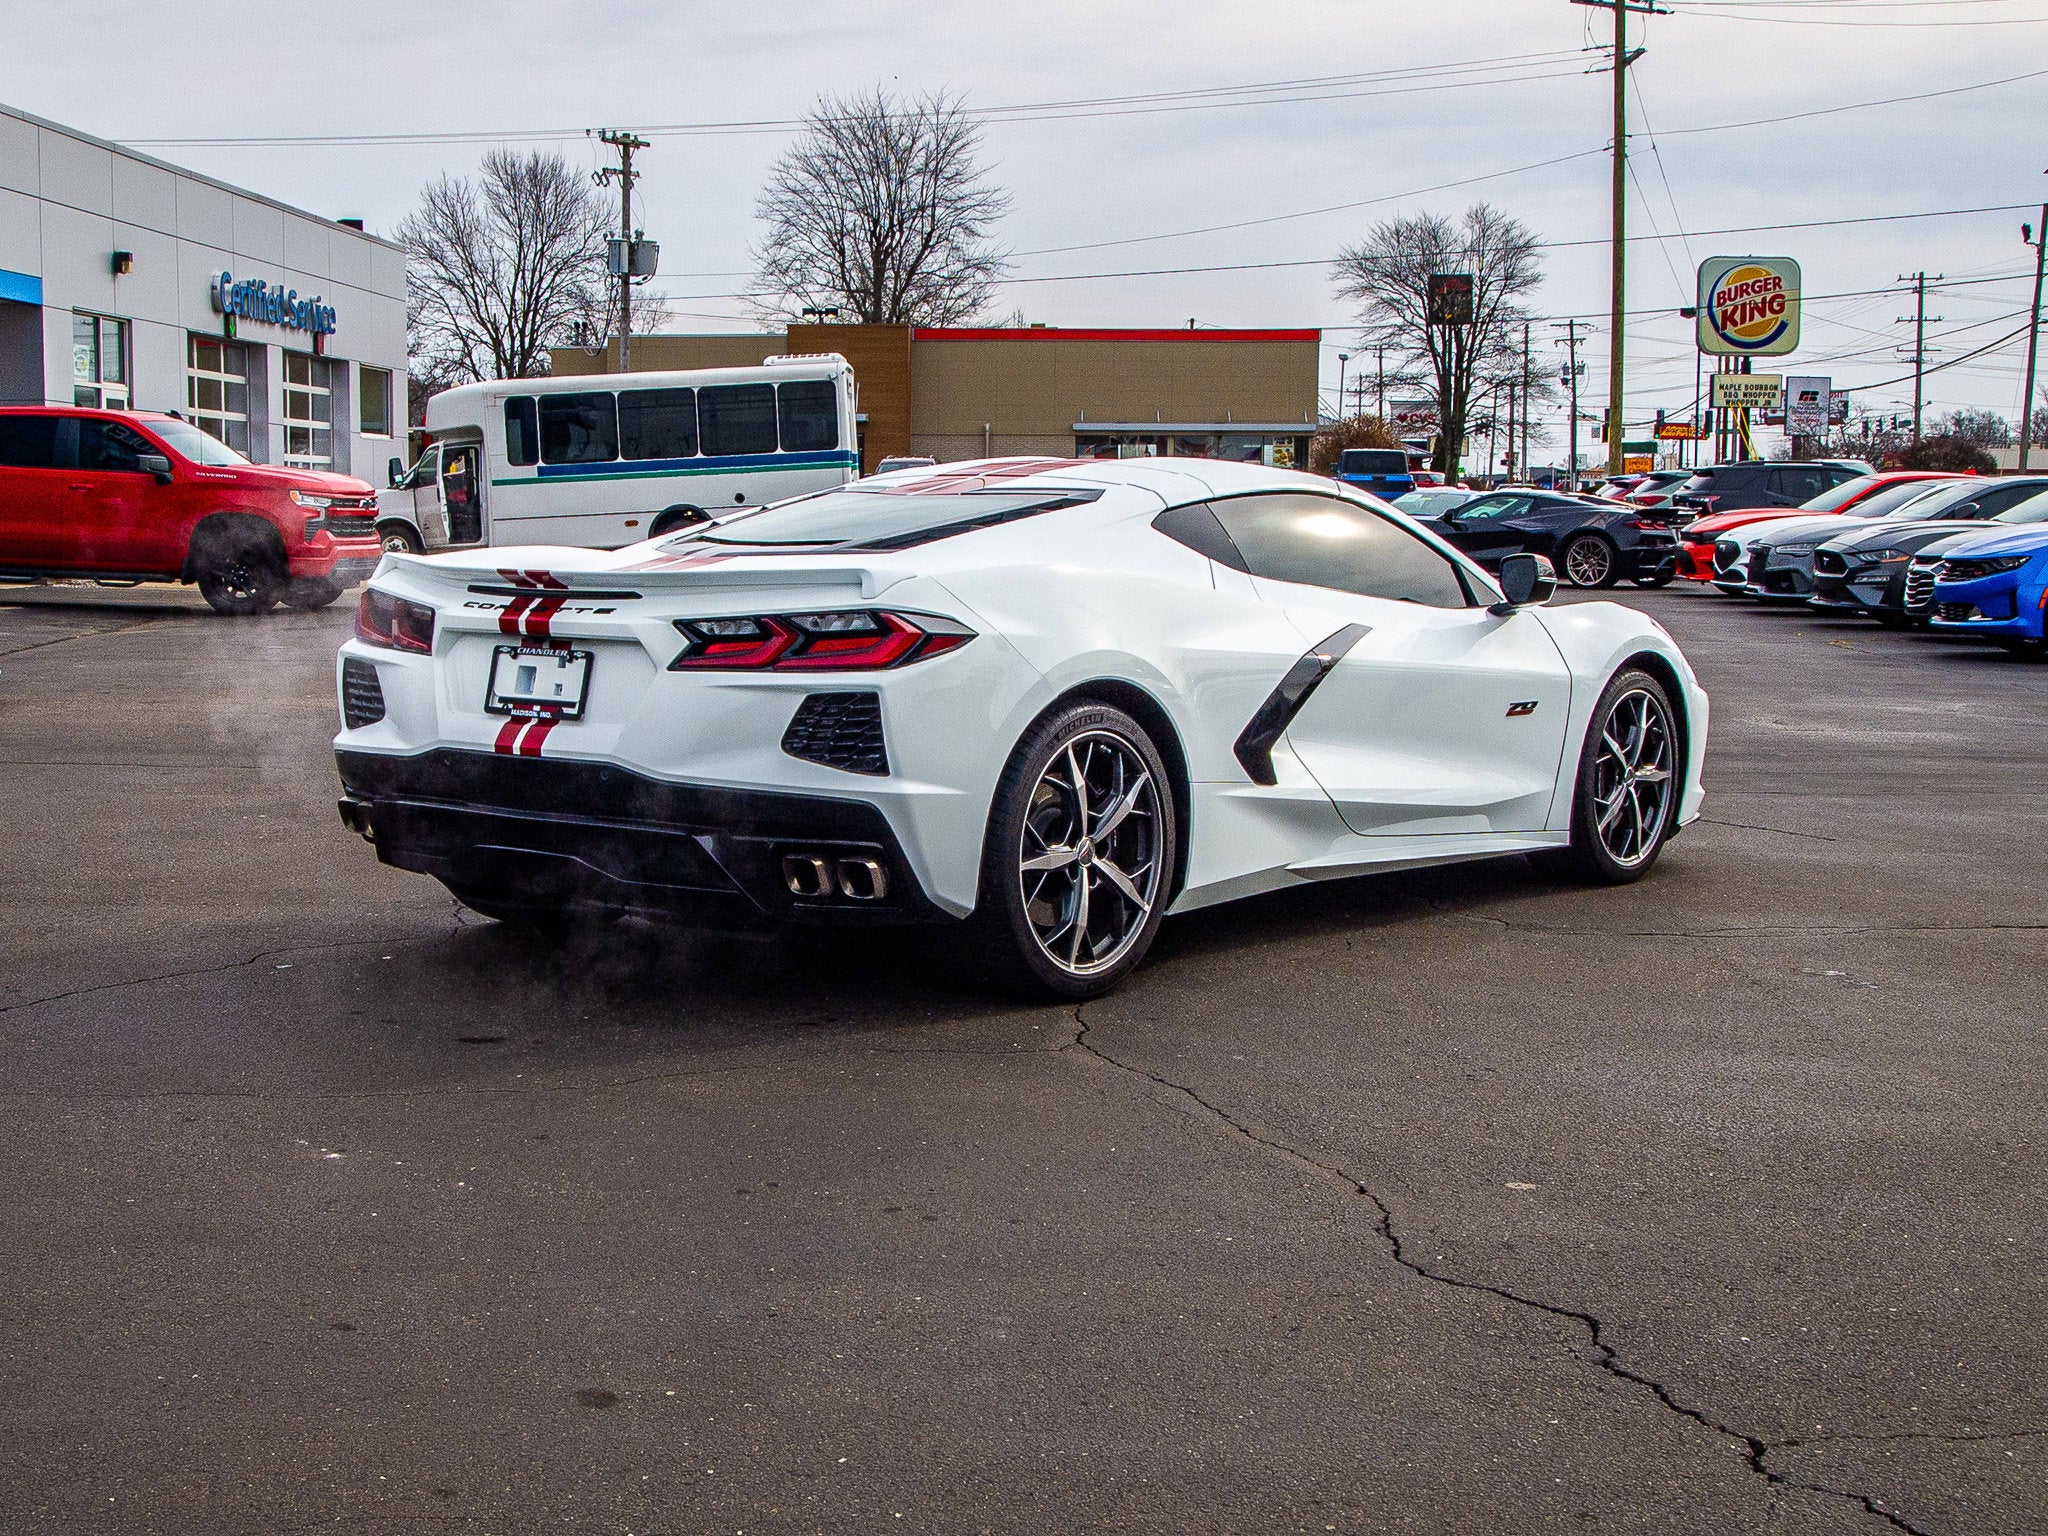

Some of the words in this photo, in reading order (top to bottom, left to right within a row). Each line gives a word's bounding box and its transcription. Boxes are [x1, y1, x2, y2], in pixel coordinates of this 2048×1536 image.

[1716, 275, 1784, 309] BURGER
[219, 271, 285, 325] Certified
[287, 289, 336, 335] Service
[1720, 293, 1787, 332] KING
[1718, 383, 1742, 391] MAPLE
[1744, 383, 1779, 391] BOURBON
[1723, 391, 1739, 399] BBQ
[1742, 391, 1777, 399] WHOPPER
[1409, 413, 1436, 424] CVS
[463, 601, 617, 615] CORVETTE
[516, 647, 568, 657] CHANDLER
[1058, 713, 1102, 740] MICHELIN
